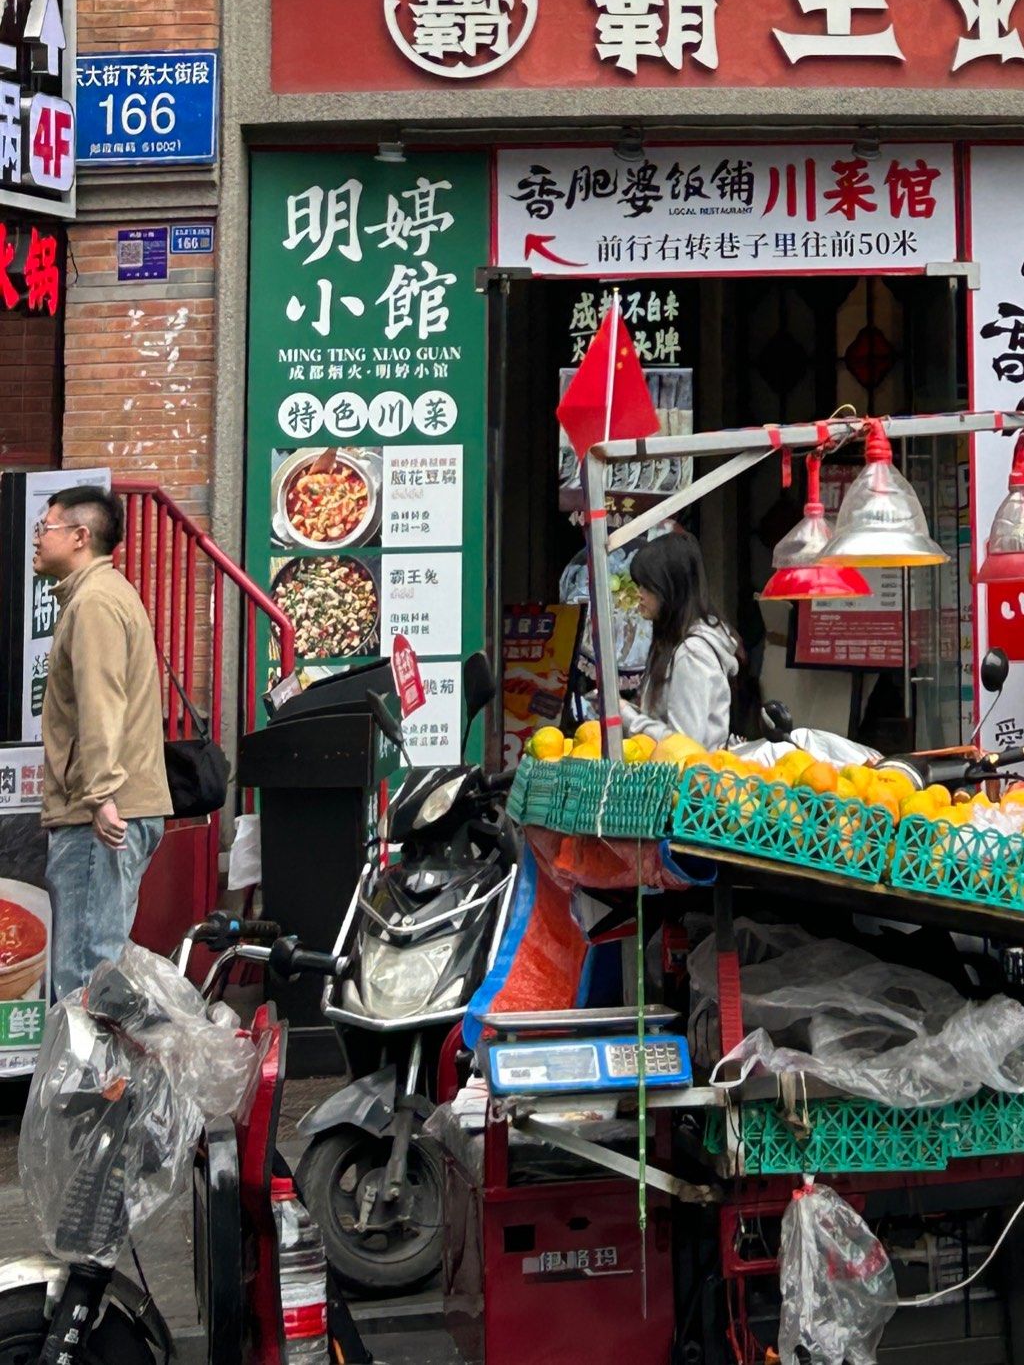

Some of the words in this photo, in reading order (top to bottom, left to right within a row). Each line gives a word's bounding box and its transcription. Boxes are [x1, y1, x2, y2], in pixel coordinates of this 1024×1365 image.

[98, 92, 176, 135] 166
[33, 106, 72, 179] 4F
[508, 159, 755, 219] 香肥婆饭铺
[762, 158, 942, 222] 川菜馆
[282, 176, 455, 265] 明婷
[597, 230, 918, 262] 前行右转巷子里往前50米
[278, 348, 322, 363] MING
[327, 348, 366, 362] TING
[373, 347, 411, 361] XIAO
[416, 346, 462, 360] GUAN
[570, 326, 682, 364] 火头牌
[287, 397, 448, 433] 特色川菜
